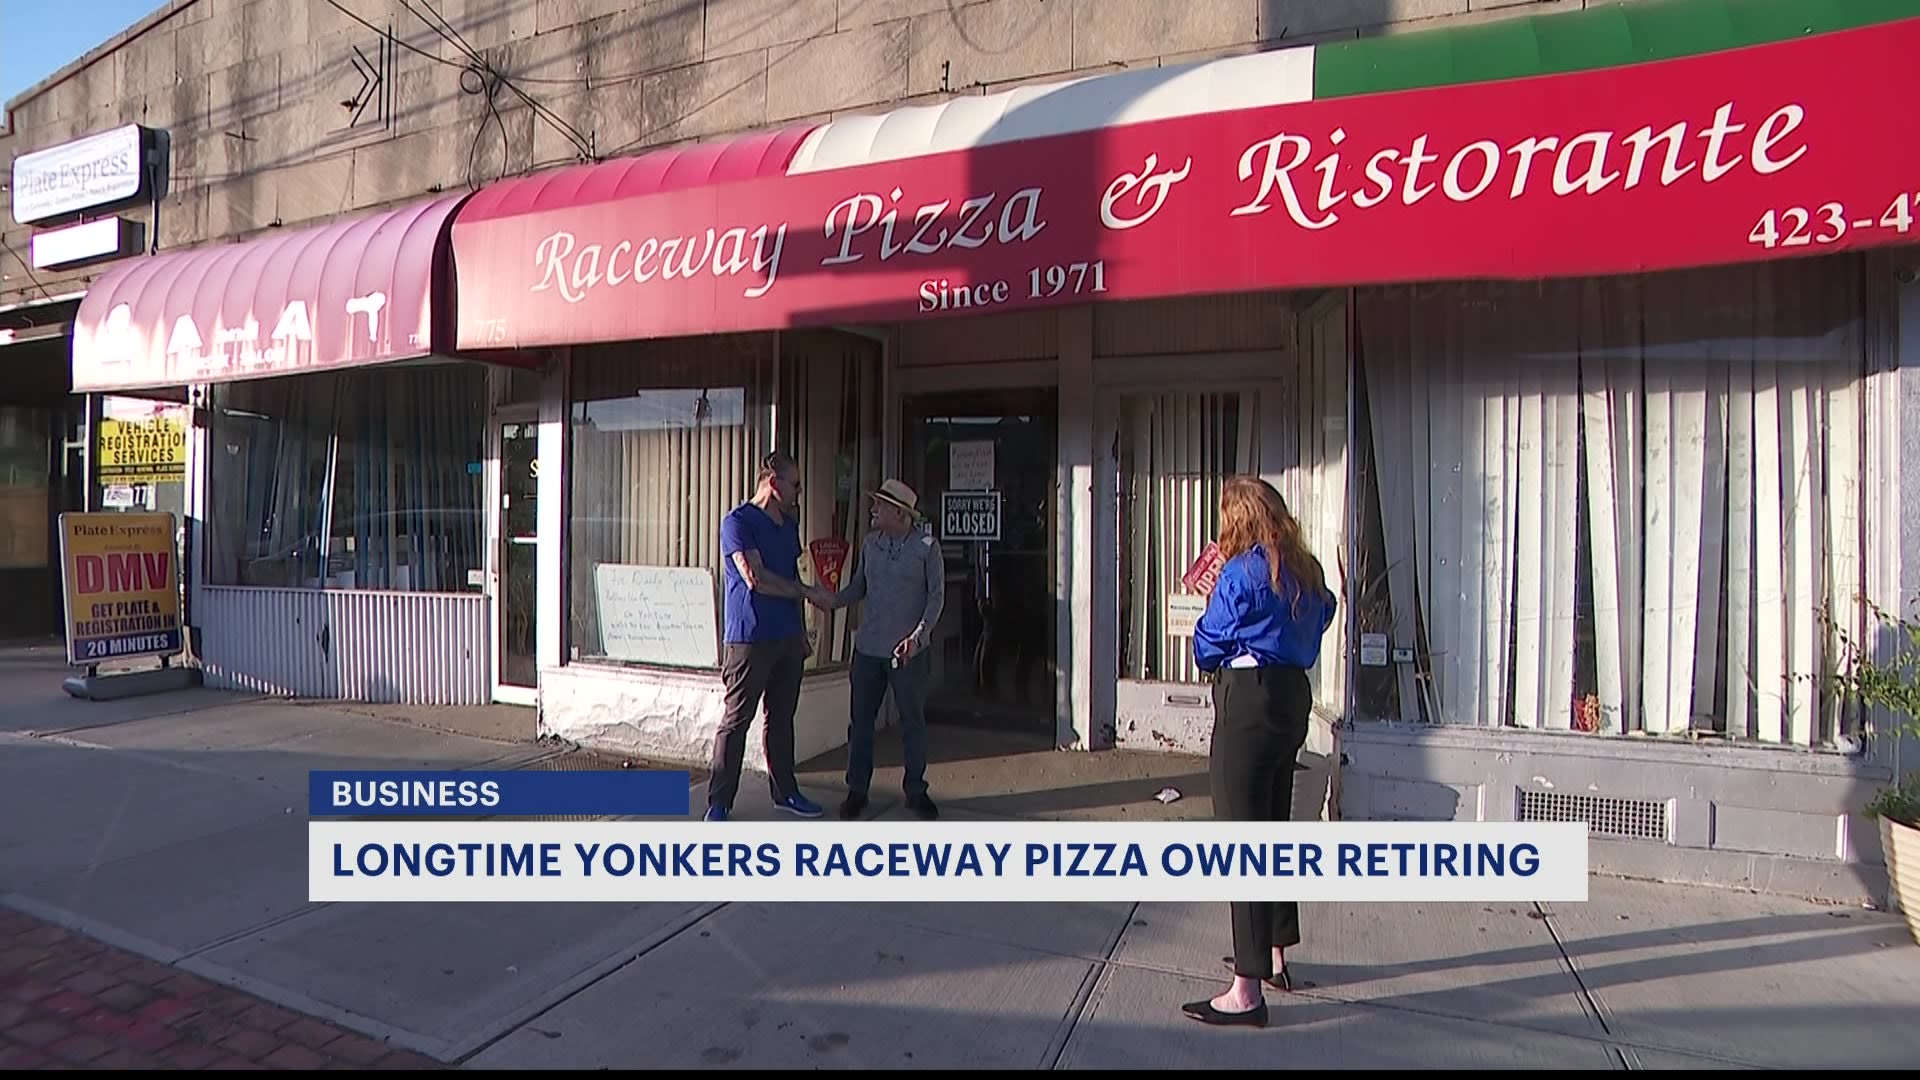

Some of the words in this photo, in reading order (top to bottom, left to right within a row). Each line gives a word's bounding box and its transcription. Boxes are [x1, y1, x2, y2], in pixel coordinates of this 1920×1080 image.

[19, 168, 57, 197] Plate
[60, 151, 128, 191] Express
[529, 222, 788, 303] Raceway
[819, 186, 1048, 266] Pizza
[1100, 152, 1192, 231] &
[1229, 101, 1808, 230] Ristorante
[918, 275, 1010, 313] Since
[1026, 259, 1108, 300] 1971
[475, 319, 507, 344] 775
[117, 418, 170, 435] VEHICLE
[113, 448, 174, 464] SERVICES
[73, 524, 108, 537] Plate
[110, 523, 163, 538] Express
[947, 512, 995, 534] CLOSED
[75, 551, 169, 595] DMV
[91, 602, 113, 618] GET
[116, 600, 150, 616] PLATE
[152, 601, 160, 613] &
[75, 616, 161, 636] REGISTRATION
[164, 614, 175, 630] IN
[87, 641, 107, 657] 20
[109, 634, 169, 654] MINUTES
